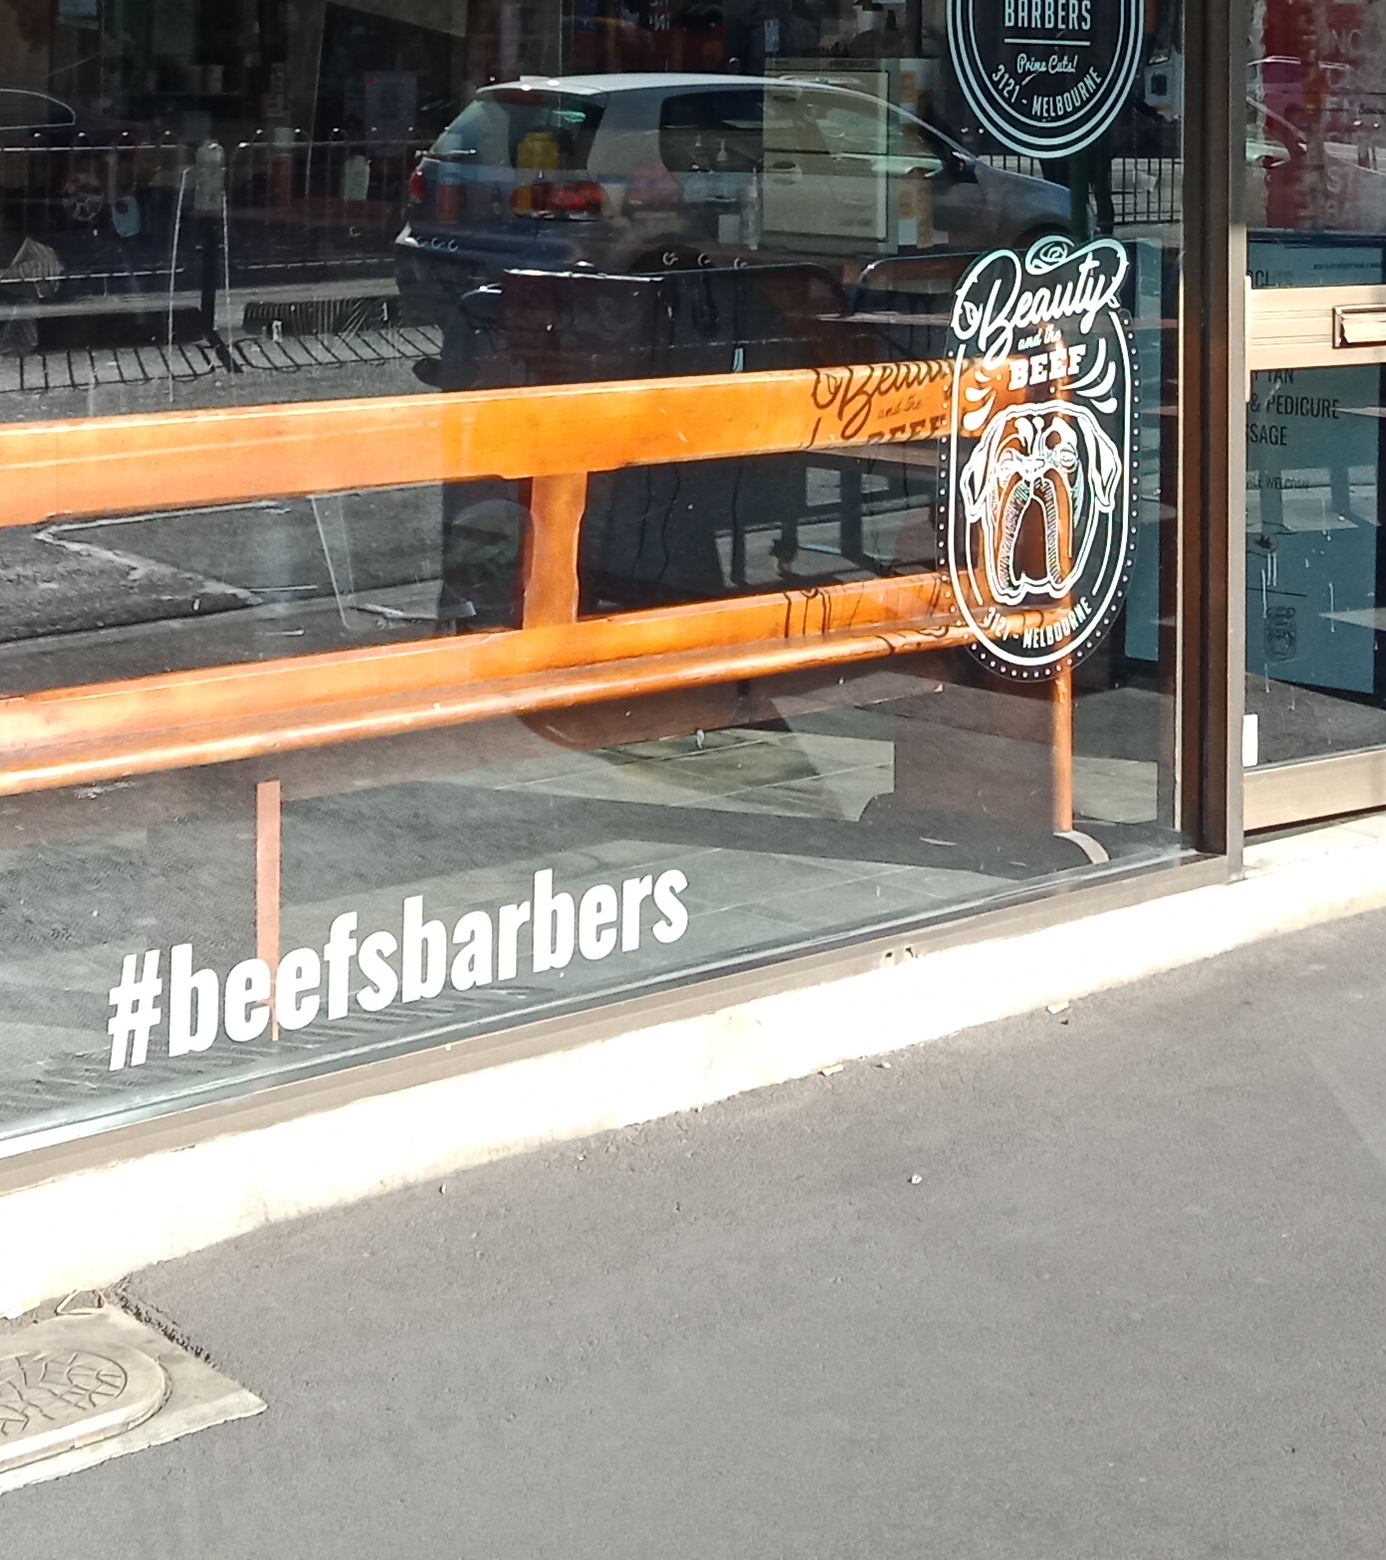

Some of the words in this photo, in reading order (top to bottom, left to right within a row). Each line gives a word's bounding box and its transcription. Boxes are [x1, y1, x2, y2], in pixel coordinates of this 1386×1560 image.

[1017, 53, 1047, 74] Prime
[1048, 55, 1078, 74] Cuts!
[992, 64, 1020, 103] 3121
[1032, 66, 1102, 117] MELBOURNE
[951, 238, 1128, 370] Beauty
[1018, 329, 1043, 350] and
[1009, 344, 1086, 390] BEEF
[1266, 395, 1340, 419] PEDICURE
[983, 606, 1010, 641] 3121
[1022, 596, 1093, 649] MELBOURNE
[109, 868, 688, 1071] #beefsbarbers
